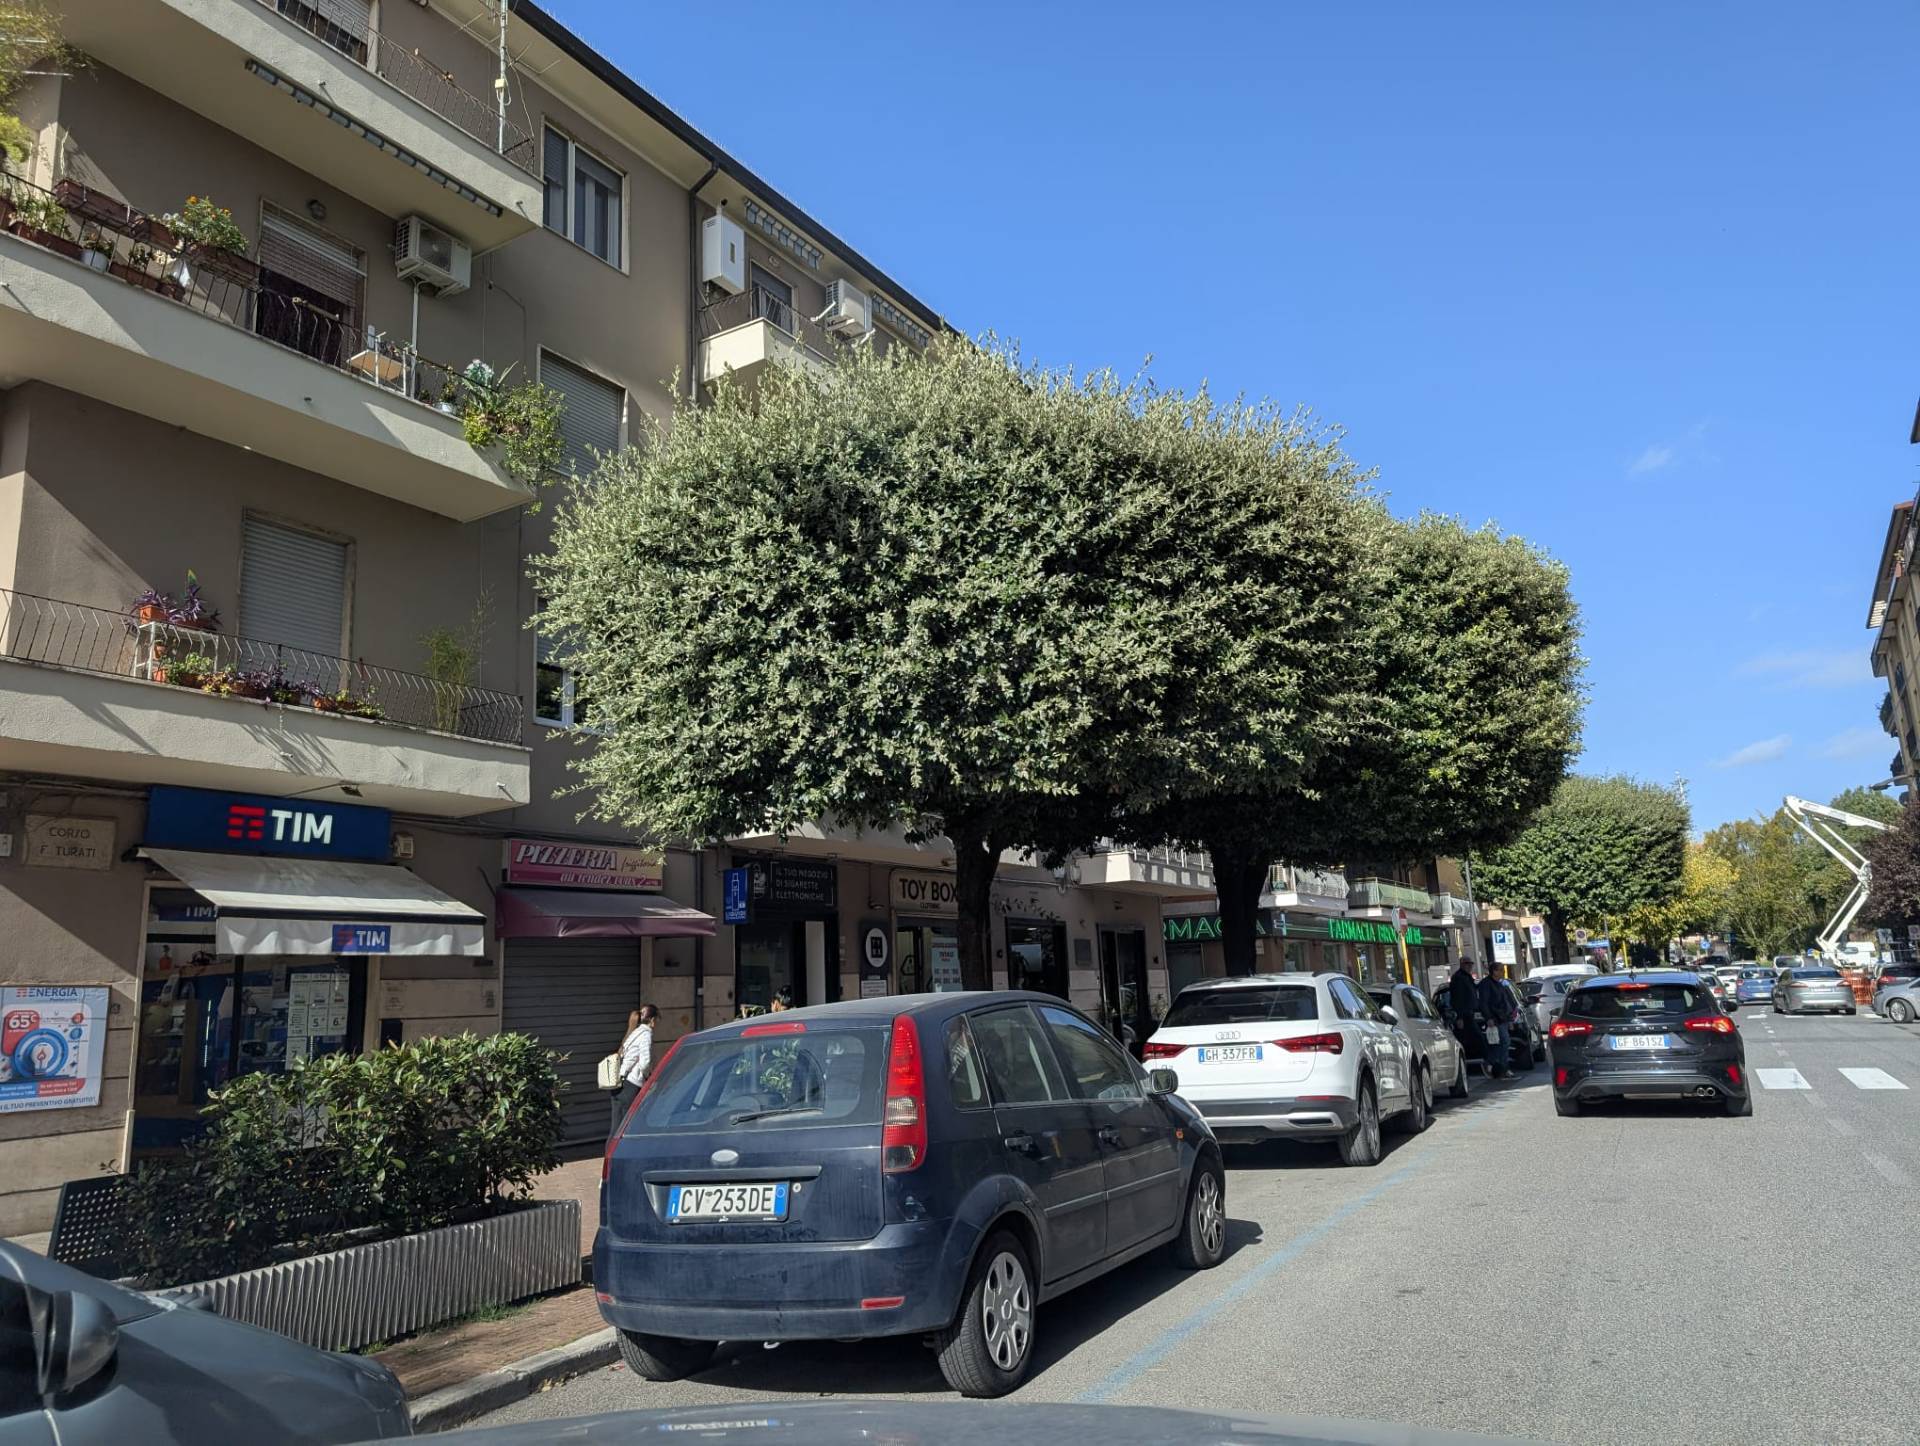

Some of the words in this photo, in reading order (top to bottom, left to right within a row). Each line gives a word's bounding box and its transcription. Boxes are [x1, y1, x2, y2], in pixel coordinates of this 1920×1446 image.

[48, 827, 91, 840] CORSO
[271, 809, 333, 844] TIM
[56, 846, 96, 858] TURATI
[516, 844, 618, 870] PIZZERIA
[899, 879, 928, 900] TOY
[931, 881, 959, 902] BOX
[356, 930, 386, 947] TIM
[1328, 918, 1376, 942] FARMACIA
[28, 987, 78, 997] ENERGIA
[1206, 1049, 1219, 1061] GH
[1222, 1047, 1256, 1060] 337FR
[25, 1099, 62, 1108] PREVENTIVO
[681, 1188, 705, 1213] CV
[711, 1187, 773, 1212] 253DE
